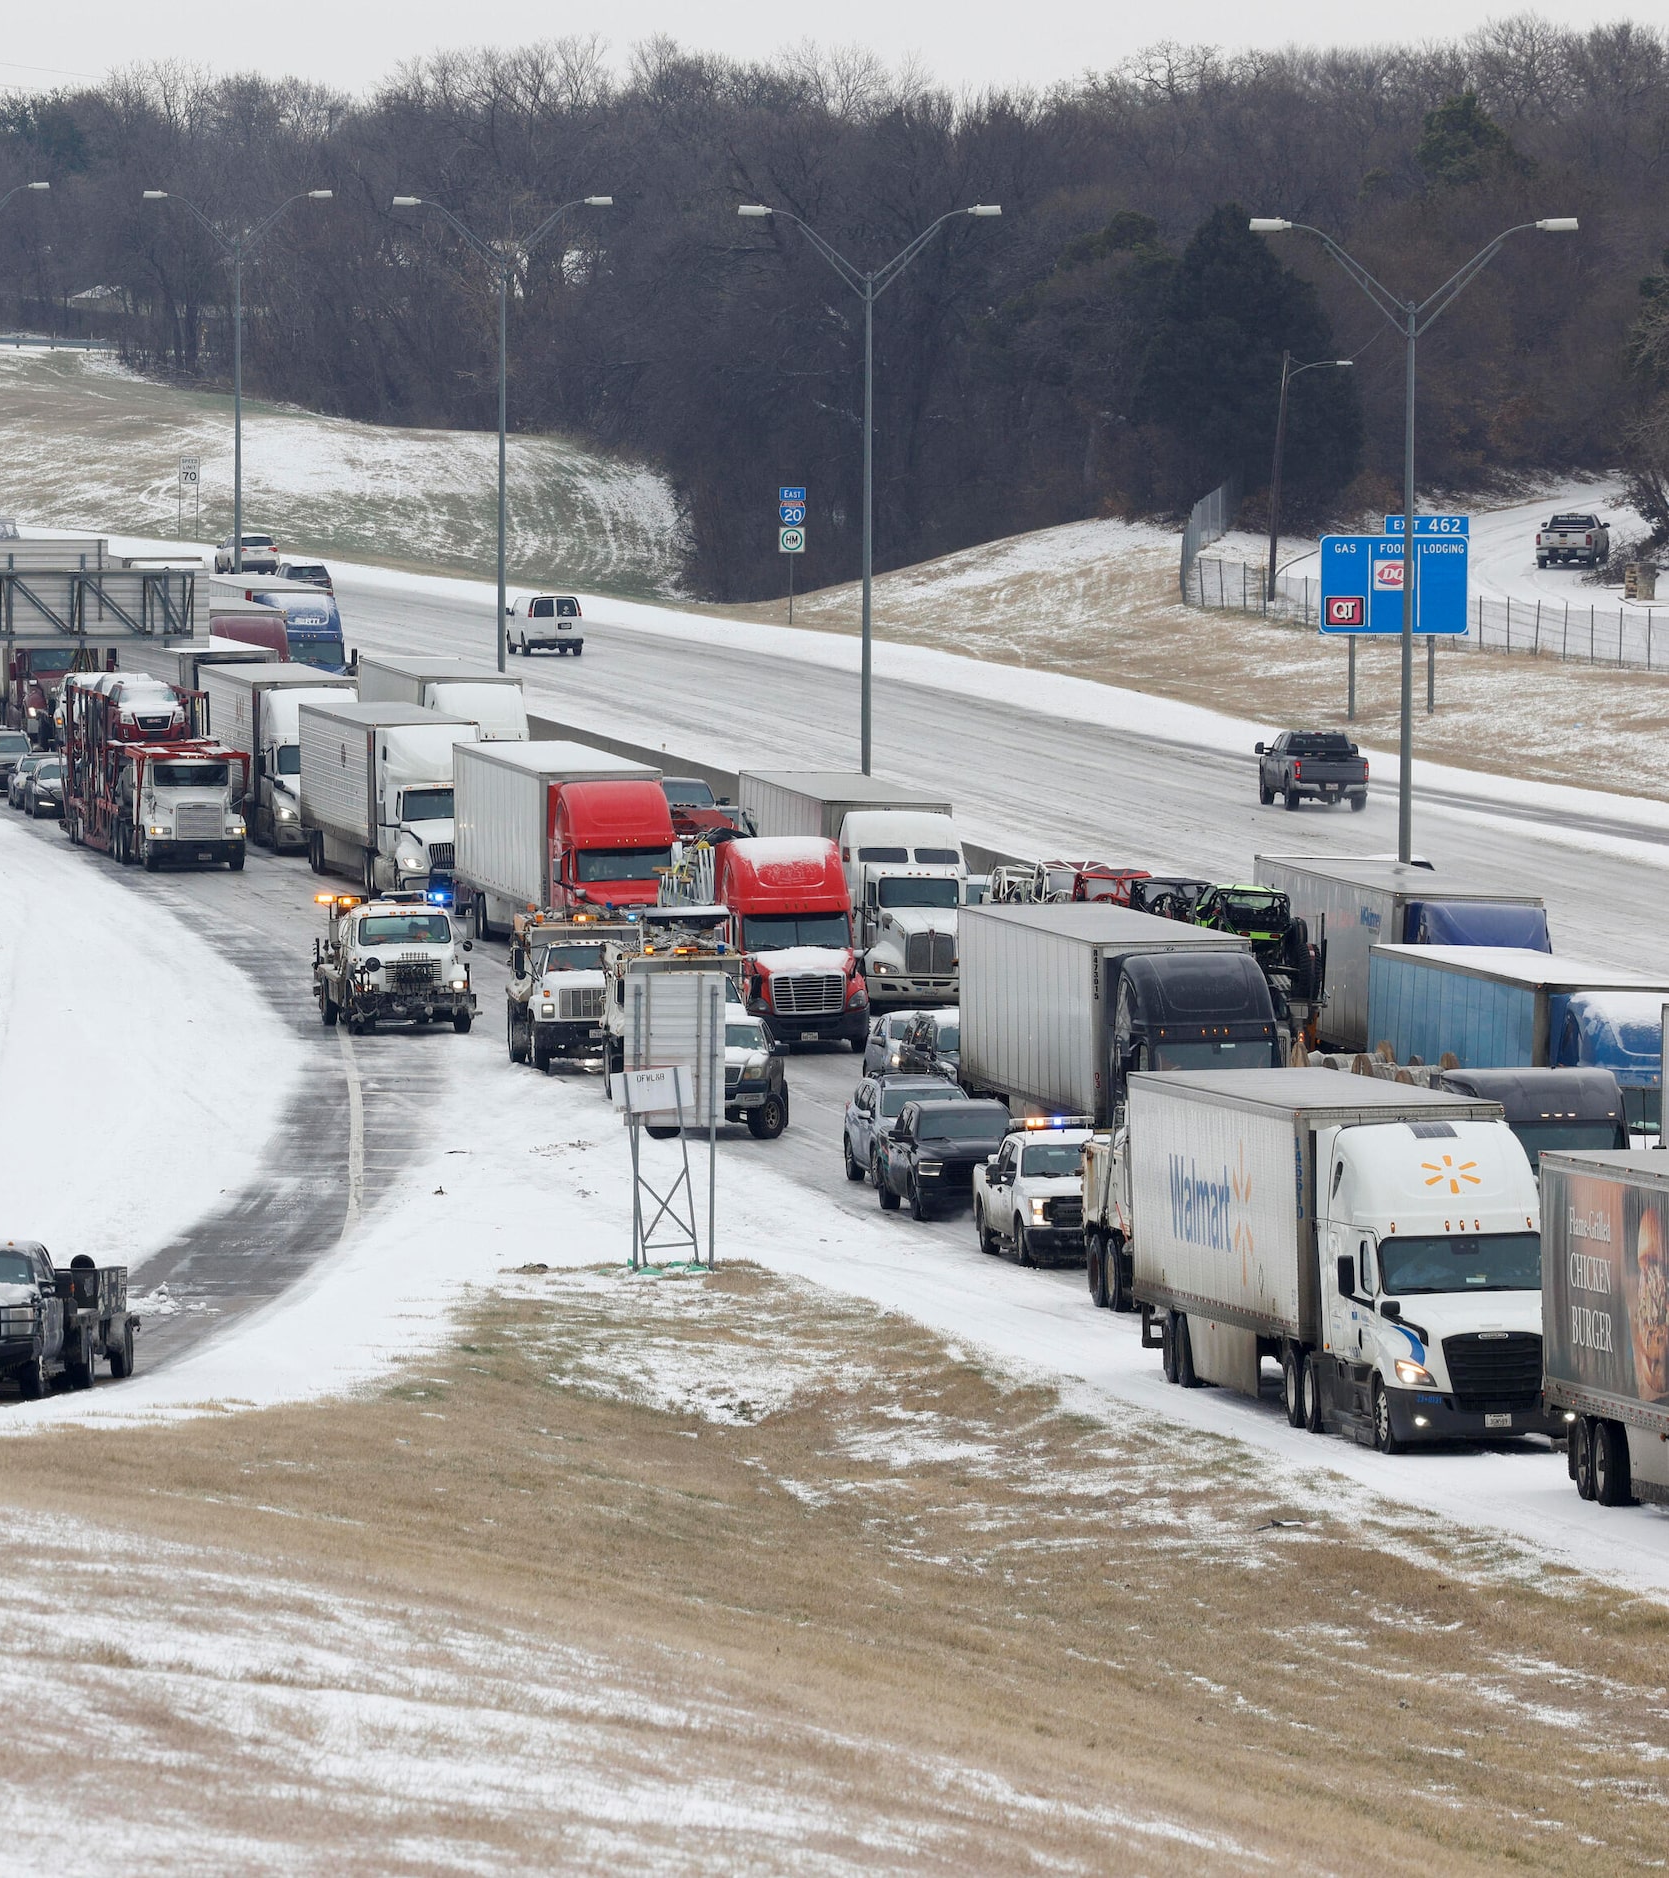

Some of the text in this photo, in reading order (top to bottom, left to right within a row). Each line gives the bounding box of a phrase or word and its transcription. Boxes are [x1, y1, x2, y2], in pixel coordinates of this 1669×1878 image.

[182, 471, 197, 481] 70
[784, 489, 801, 499] EAST
[784, 508, 802, 522] 20
[1393, 518, 1461, 533] EXT 462
[785, 535, 799, 545] HM
[1334, 543, 1357, 554] GAS
[1423, 543, 1465, 554] LODGING
[1332, 602, 1356, 619] QT
[1294, 1136, 1304, 1220] 146610
[1169, 1152, 1232, 1253] Walmart
[1569, 1207, 1611, 1243] Flame-Grilled
[1569, 1252, 1612, 1296] CHICKEN
[1571, 1305, 1613, 1353] BURGER
